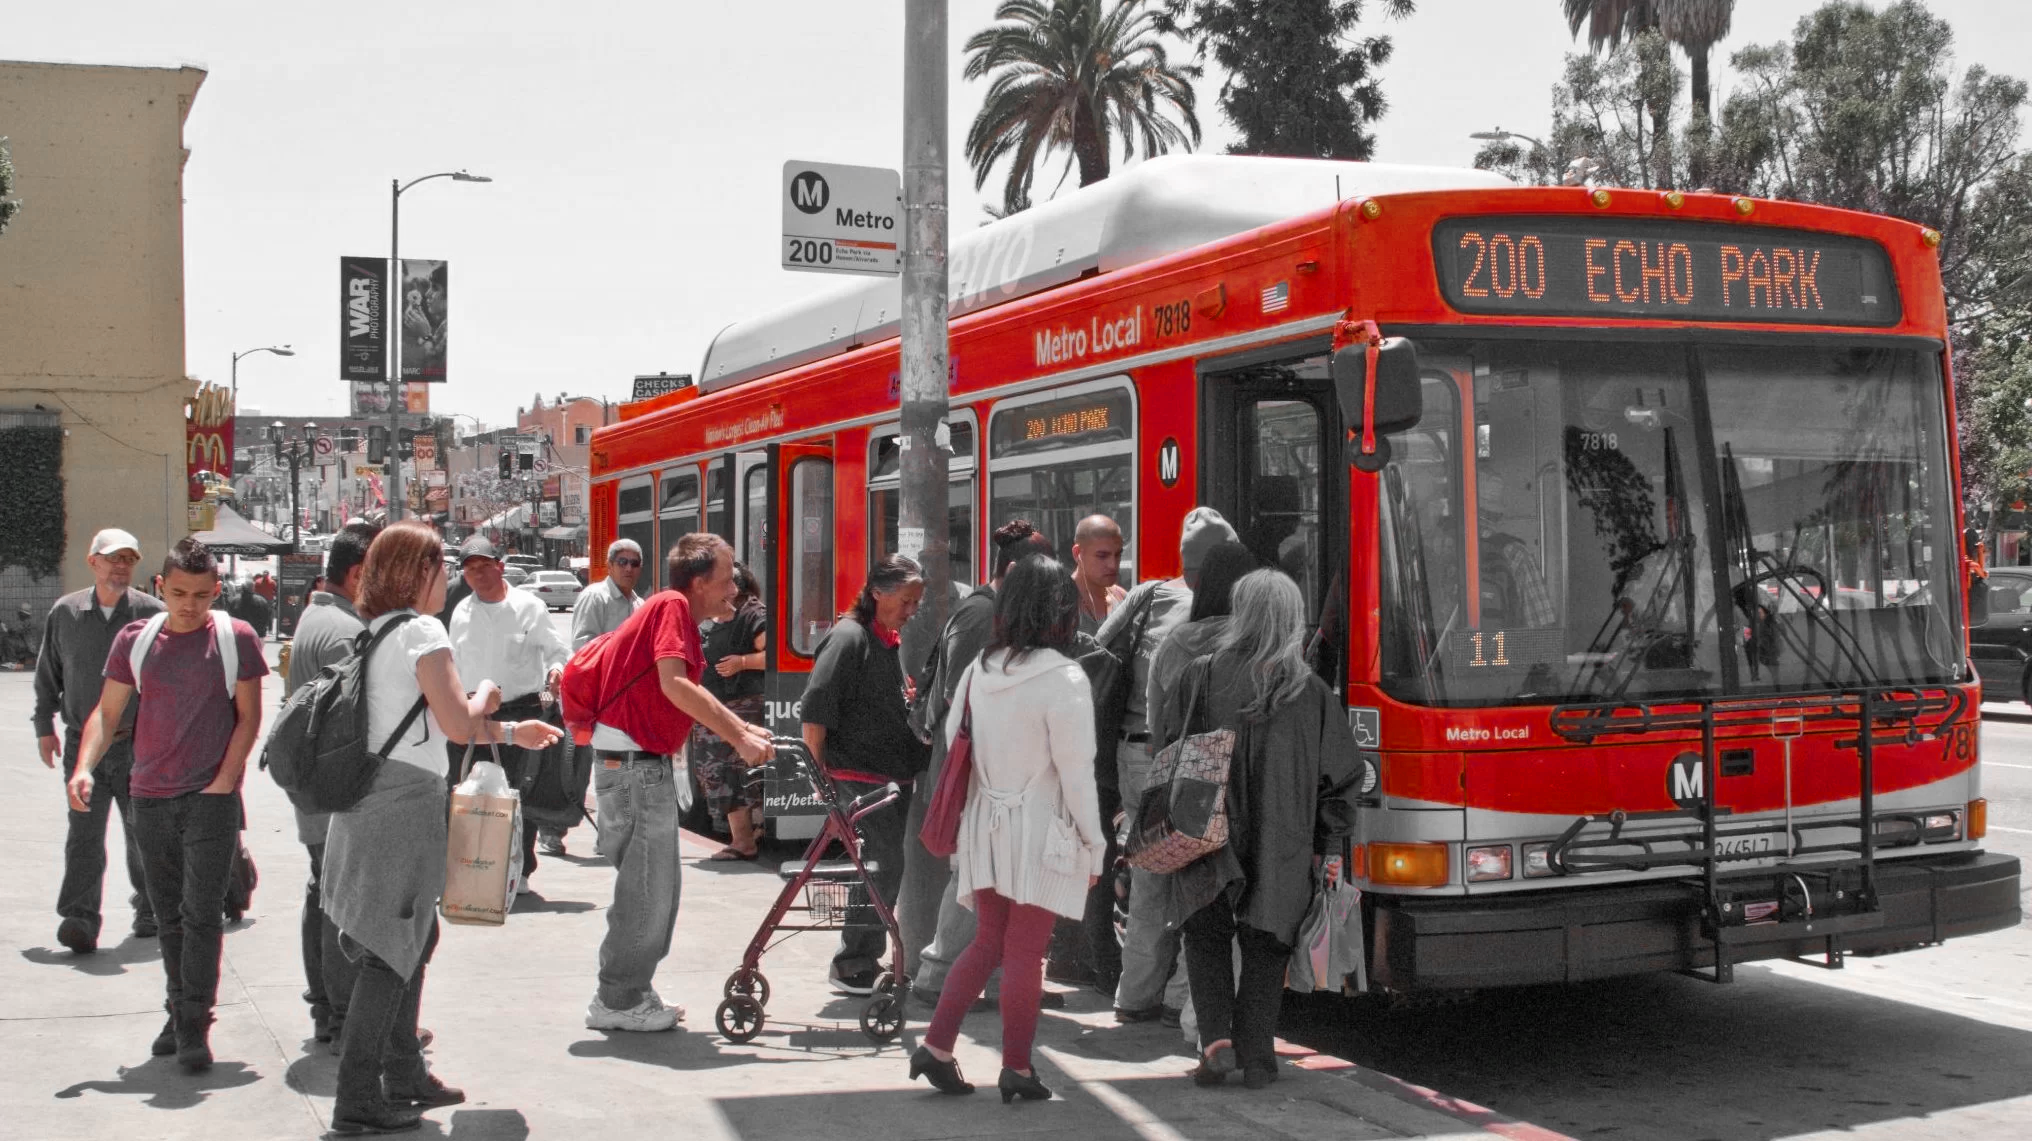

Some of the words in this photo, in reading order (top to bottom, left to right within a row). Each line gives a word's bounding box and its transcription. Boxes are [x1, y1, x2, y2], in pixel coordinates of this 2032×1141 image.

[797, 179, 823, 208] M
[836, 208, 894, 230] Metro
[789, 240, 833, 264] 200
[1460, 232, 1546, 299] 200
[1585, 238, 1694, 305] ECHO
[1721, 245, 1824, 310] PARK
[1035, 326, 1087, 367] Metro
[1092, 304, 1142, 353] Local
[1154, 300, 1191, 339] 7818
[635, 379, 686, 389] CHECKS
[1025, 417, 1046, 440] 200
[1051, 412, 1078, 435] ECHO
[1080, 407, 1109, 431] PARK
[1580, 432, 1618, 451] 7818
[1162, 446, 1177, 480] M
[1470, 631, 1509, 667] 11
[1446, 727, 1490, 741] Metro
[1494, 725, 1529, 740] Local
[1673, 761, 1704, 800] M
